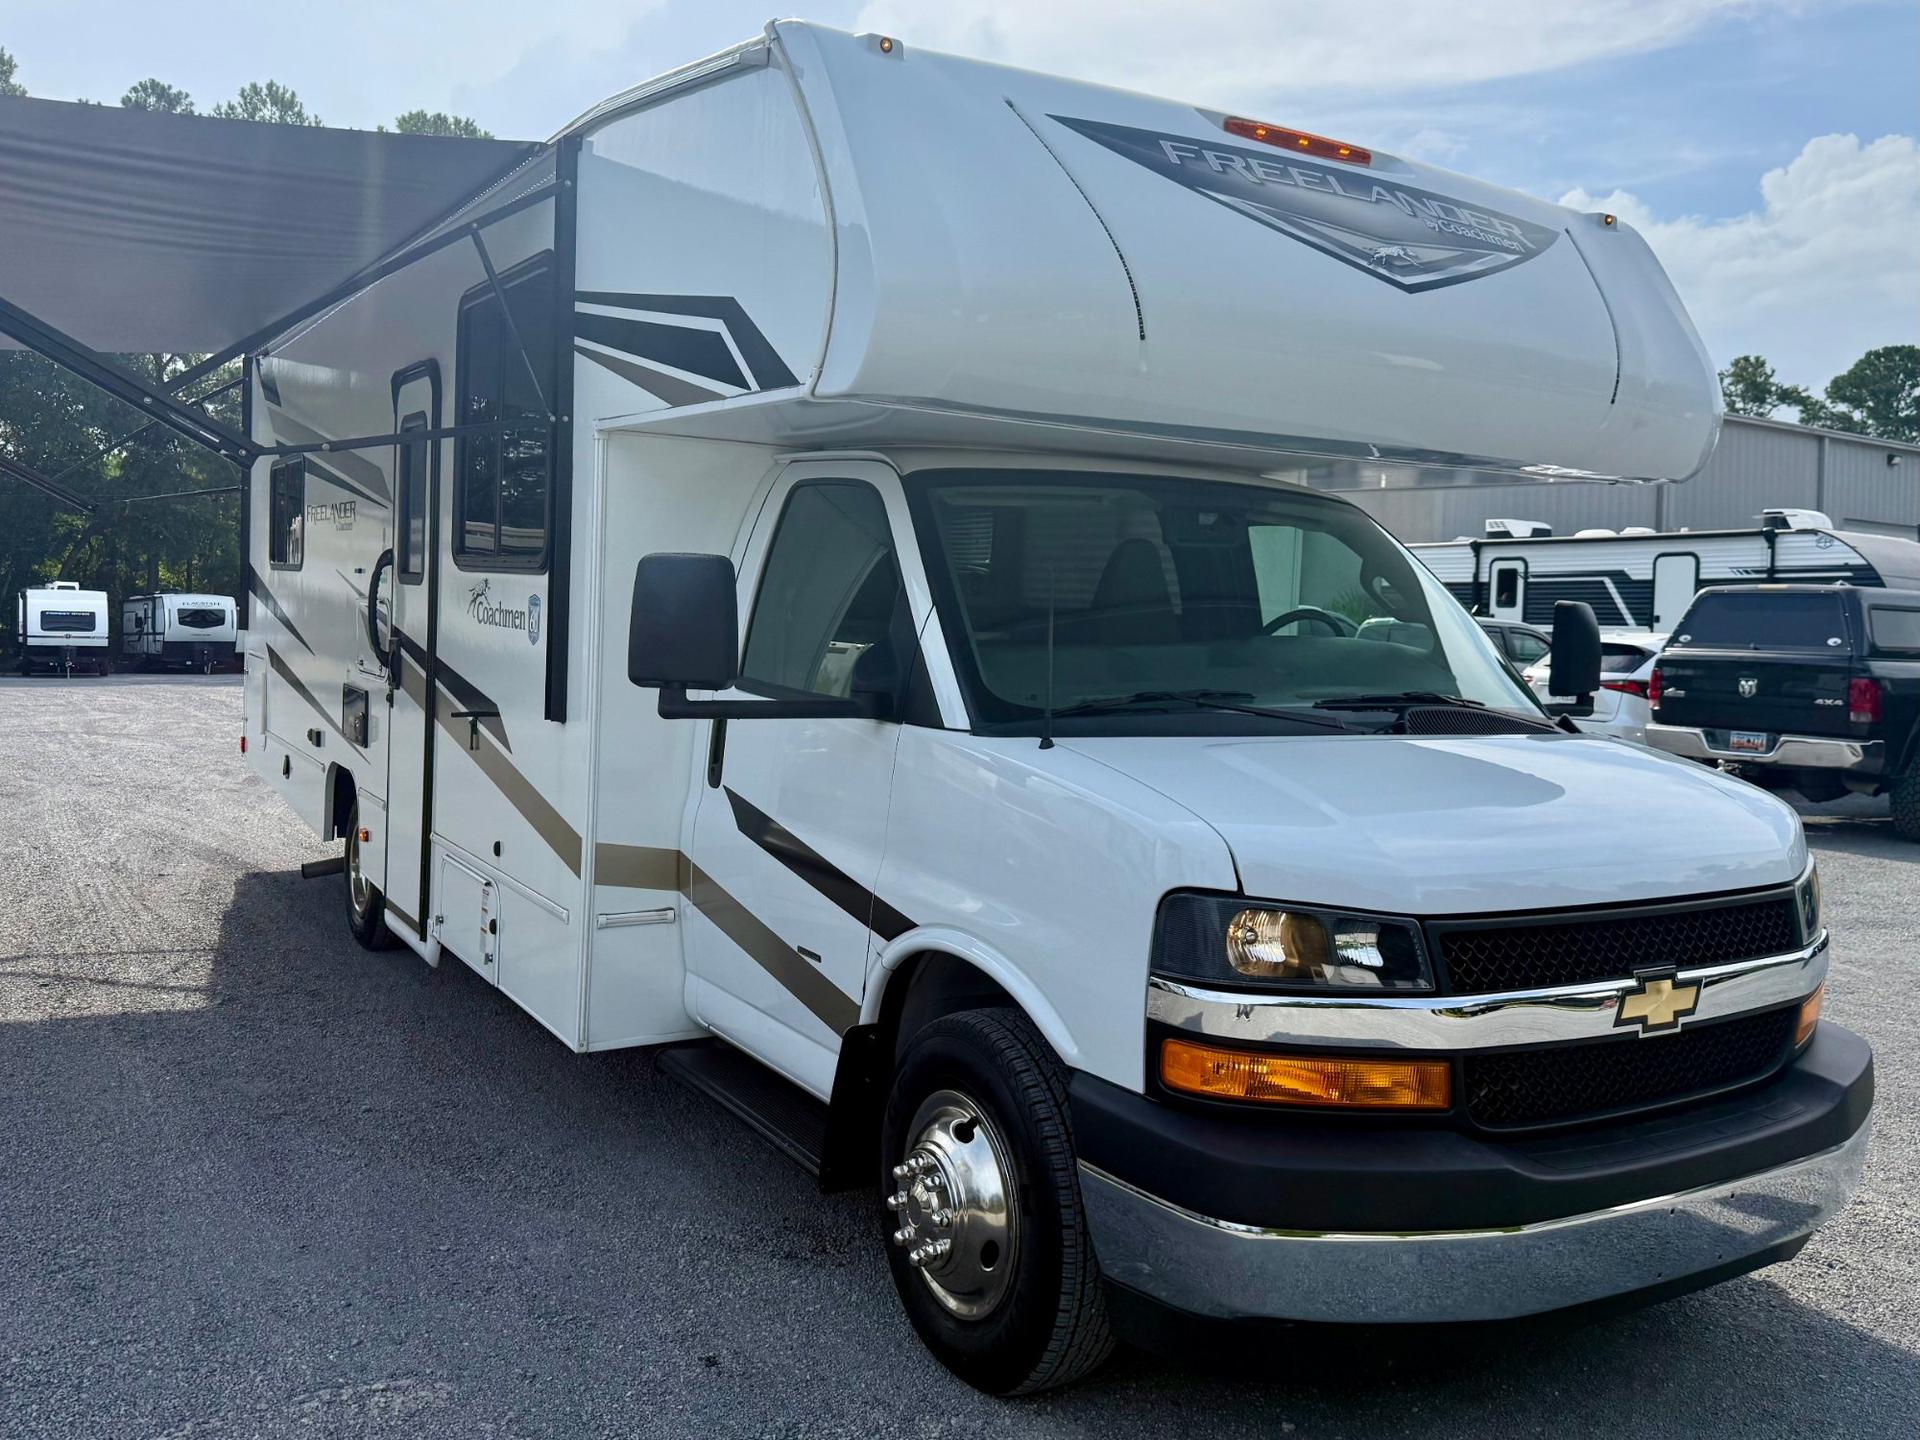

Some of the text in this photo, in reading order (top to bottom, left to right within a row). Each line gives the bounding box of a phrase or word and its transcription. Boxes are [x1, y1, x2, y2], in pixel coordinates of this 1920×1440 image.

[1158, 139, 1537, 249] FREELANDER
[1438, 219, 1526, 253] Coachmen
[306, 501, 356, 525] FREELANDER
[477, 601, 526, 630] Coachmen
